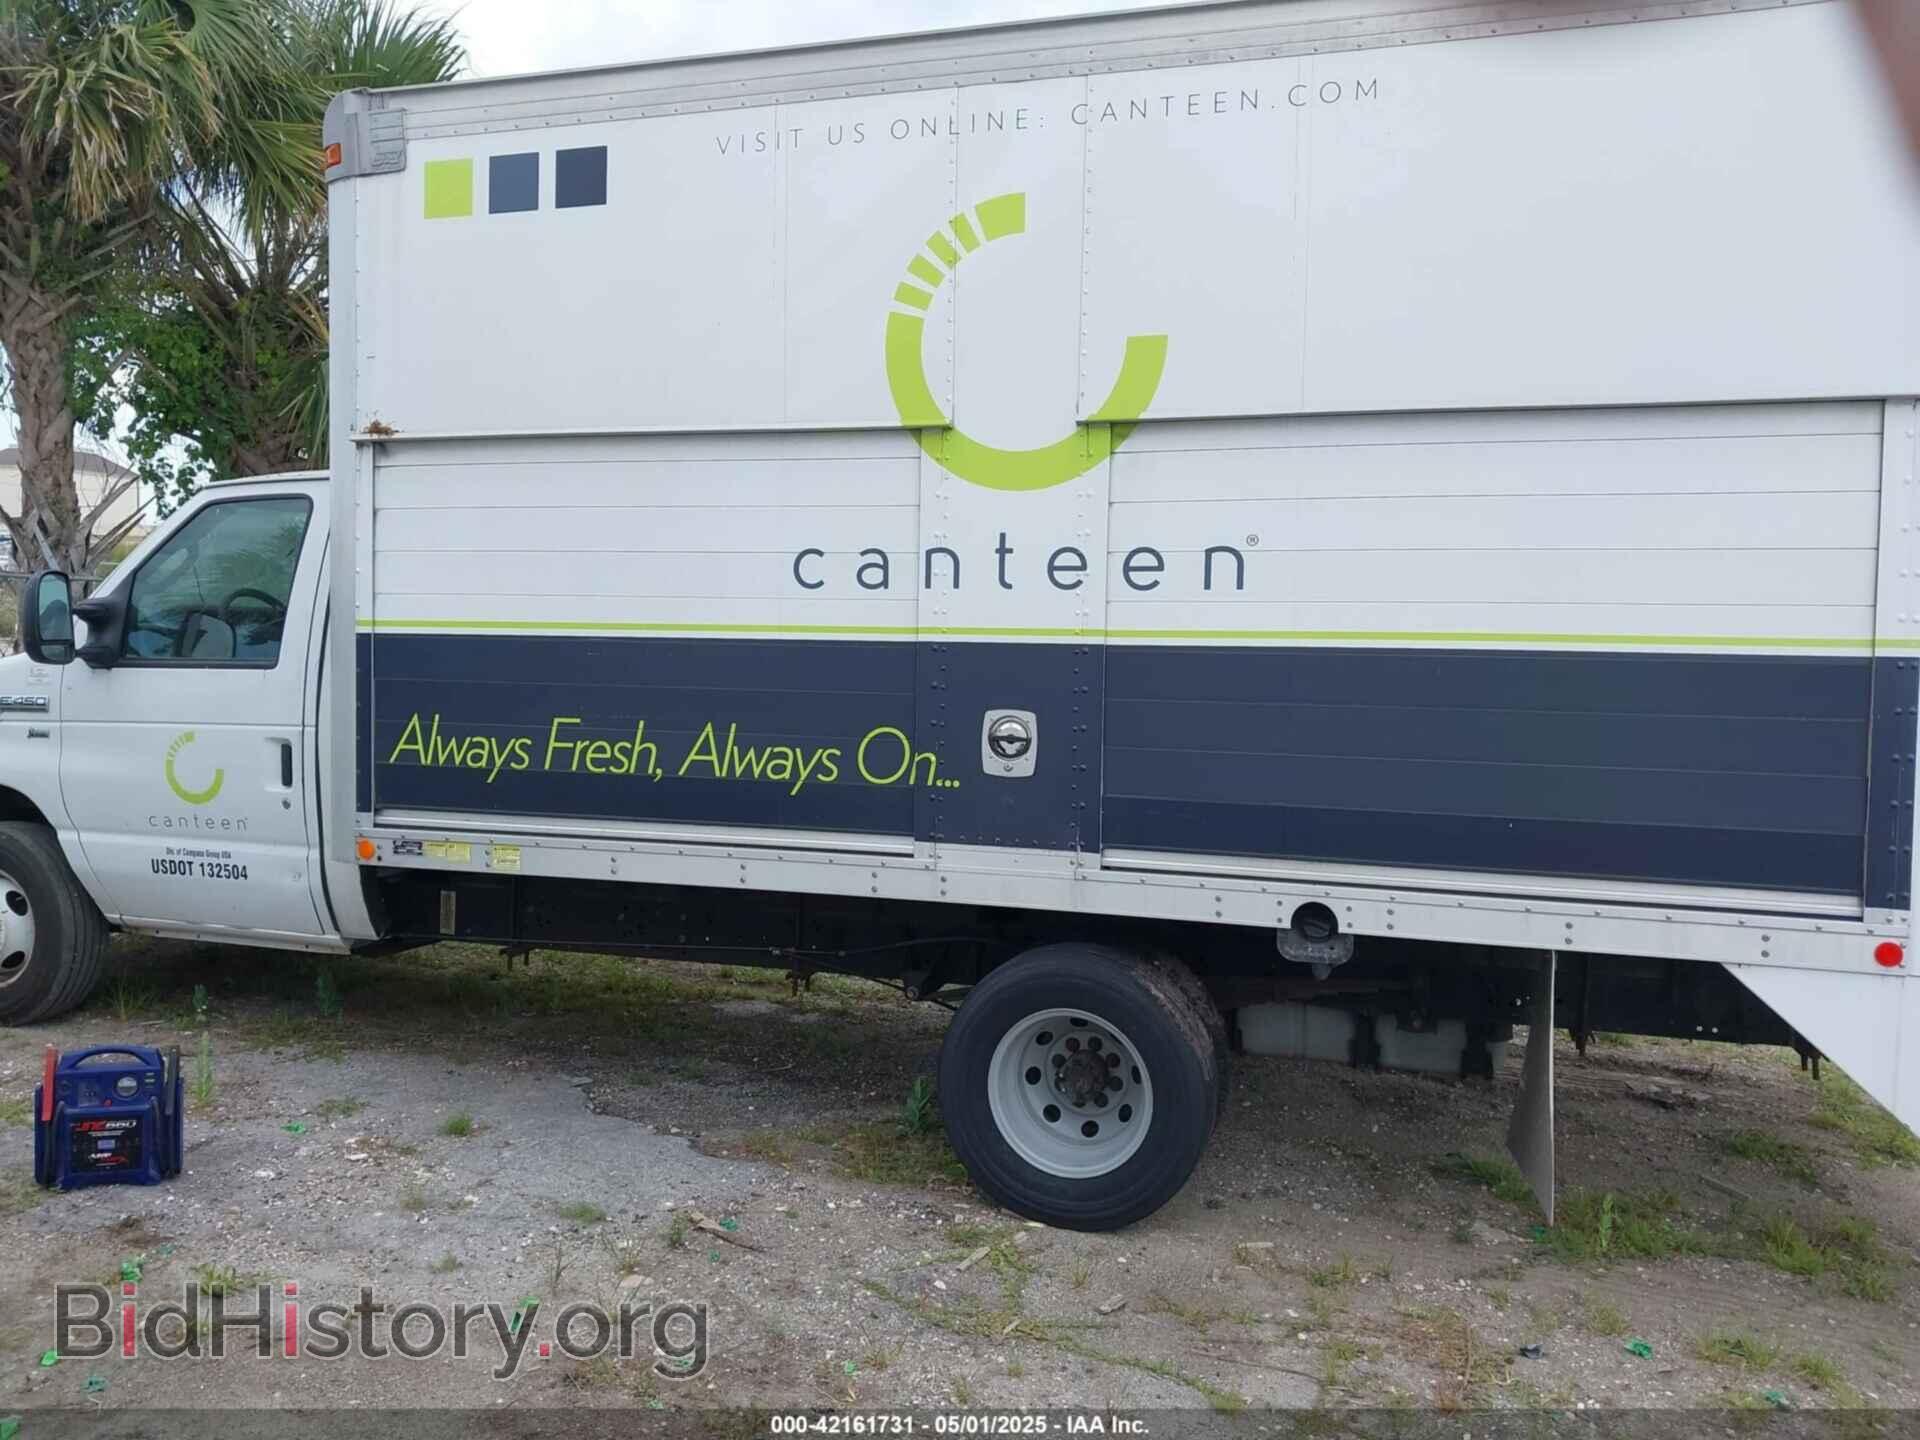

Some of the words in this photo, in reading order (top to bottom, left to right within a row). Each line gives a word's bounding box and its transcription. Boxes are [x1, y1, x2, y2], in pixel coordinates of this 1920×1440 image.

[716, 128, 804, 155] VISIT
[827, 122, 866, 146] US
[890, 108, 1044, 140] ONLINE:
[1071, 78, 1378, 125] CANTEEN.COM
[792, 532, 1245, 591] canteen
[389, 713, 532, 783] Always
[544, 717, 664, 782] Fresh,
[678, 721, 841, 796] Always
[857, 725, 960, 788] On...
[148, 813, 248, 832] canteen
[151, 858, 194, 876] USDOT
[199, 861, 248, 880] 132504
